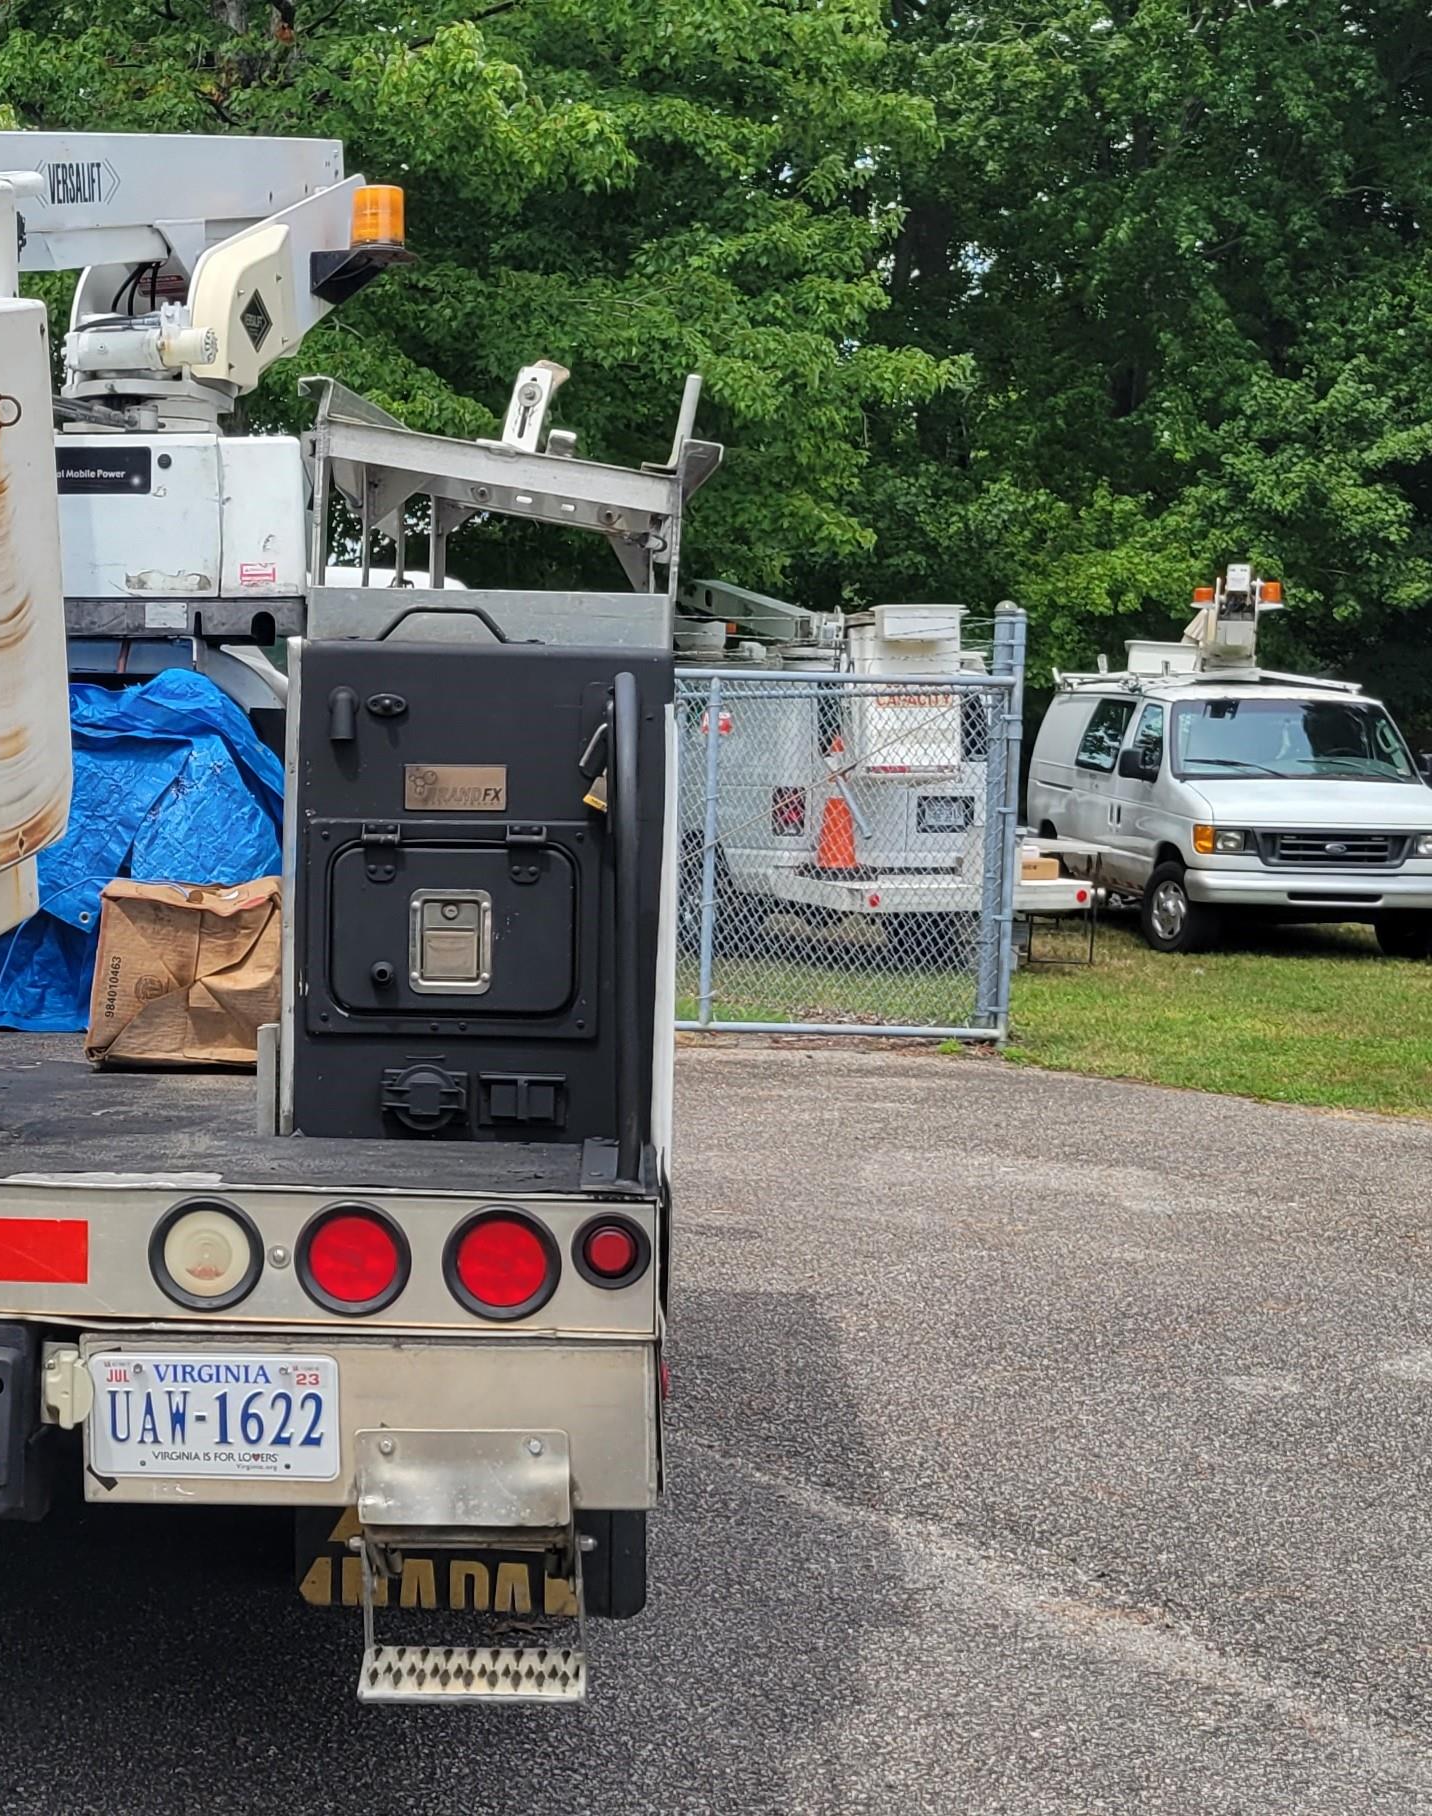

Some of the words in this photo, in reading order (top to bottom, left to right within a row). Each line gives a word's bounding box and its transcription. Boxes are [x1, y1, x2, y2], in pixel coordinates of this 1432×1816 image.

[48, 162, 102, 204] VERSALIFT
[66, 469, 95, 478] Mobile
[97, 469, 126, 478] Power
[105, 956, 121, 1017] 984010463
[106, 1369, 130, 1383] JUL
[153, 1363, 272, 1384] VIRGINIA
[295, 1373, 320, 1386] 23
[107, 1389, 325, 1448] UAW-1622
[152, 1451, 200, 1462] VIRGINIA
[202, 1451, 212, 1462] IS
[214, 1451, 236, 1462] FOR
